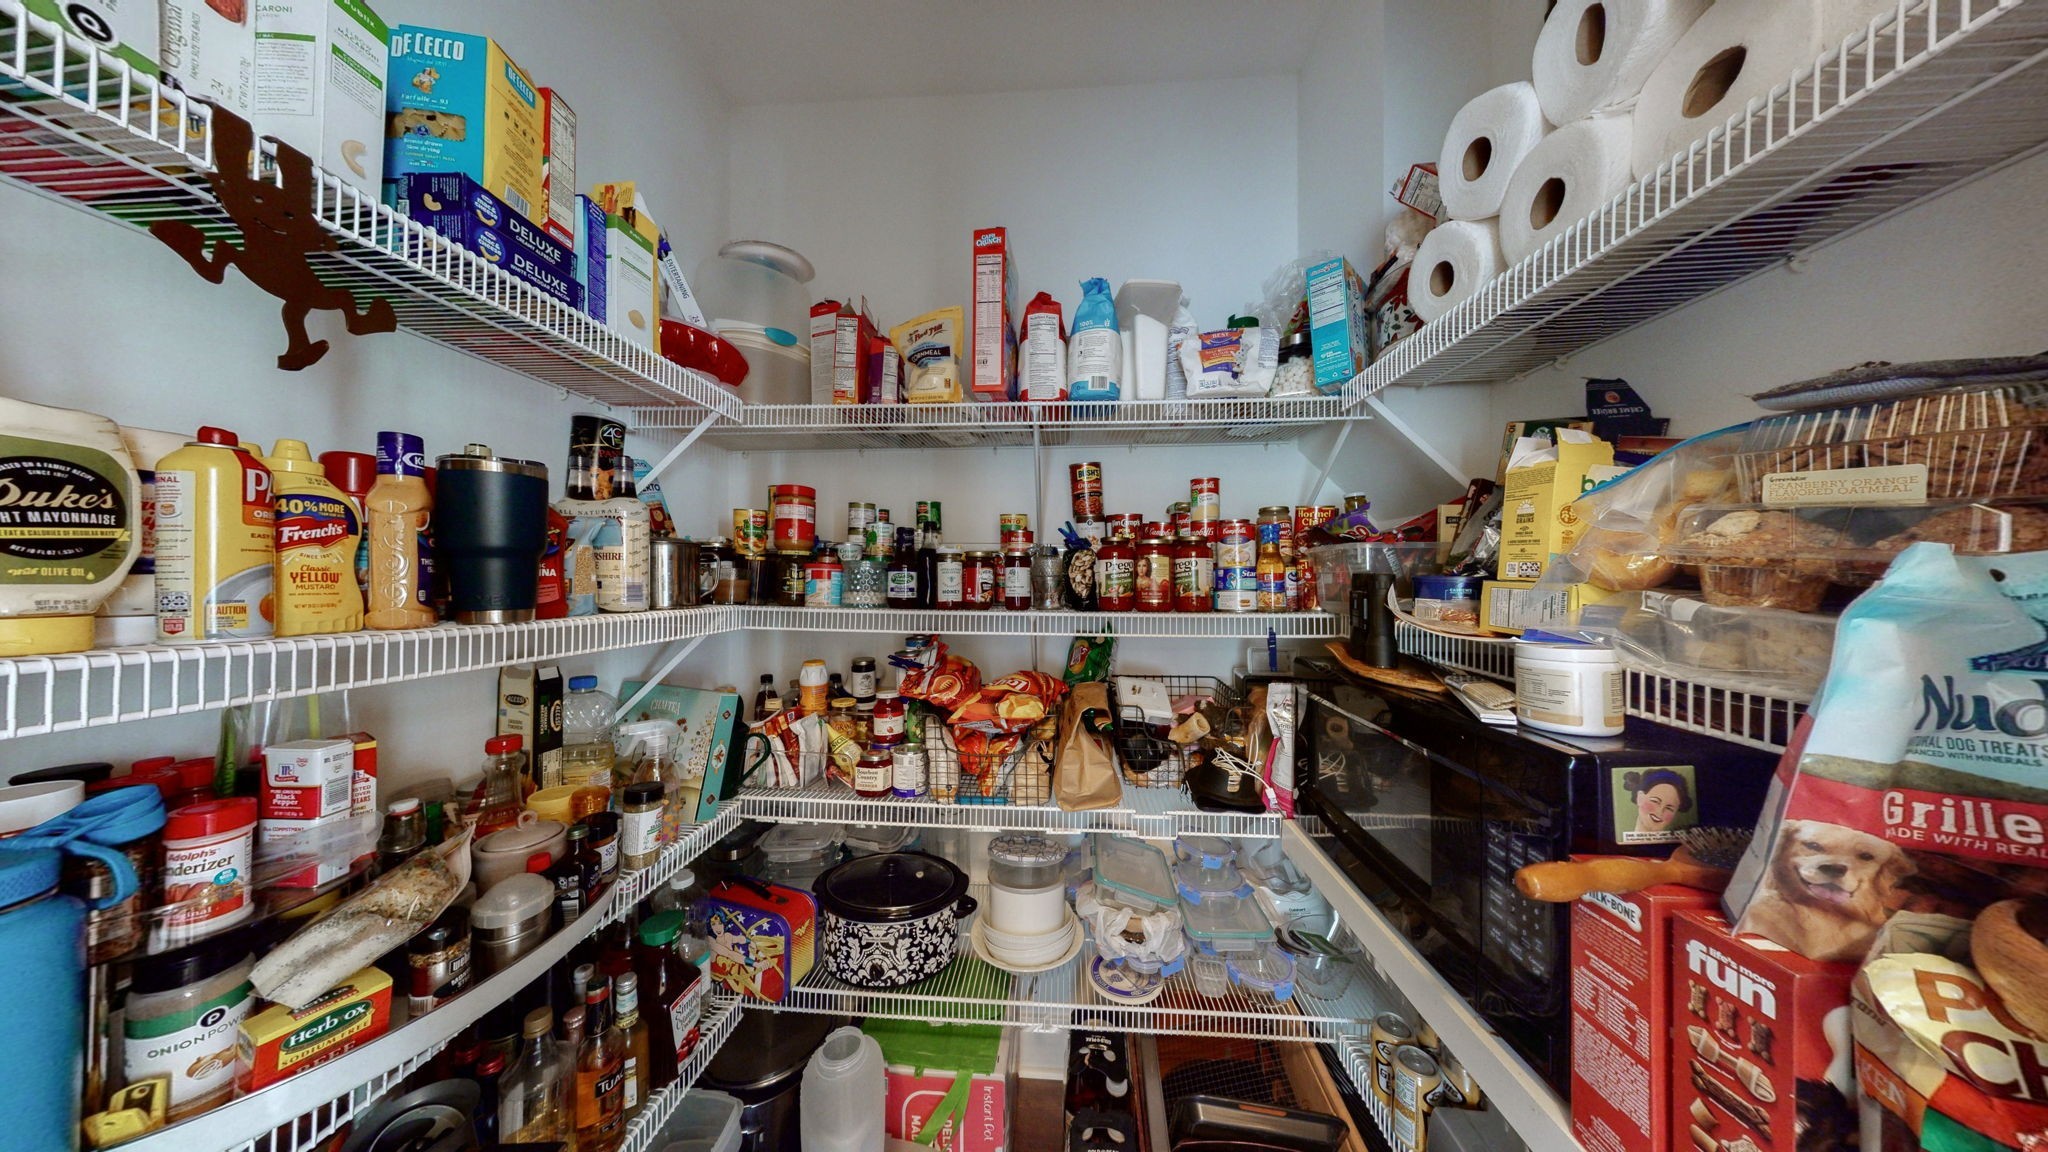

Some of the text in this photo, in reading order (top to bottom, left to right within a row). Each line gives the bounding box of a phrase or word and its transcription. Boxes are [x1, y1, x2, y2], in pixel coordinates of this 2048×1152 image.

[391, 33, 465, 61] DE CECCO
[509, 218, 562, 263] DELUXE
[976, 236, 1002, 247] CRUNCH
[514, 253, 569, 295] DELUXE
[666, 258, 690, 300] ENTERTAINING
[911, 349, 942, 362] CORNMEAL
[1769, 475, 1920, 490] CRANBERRY ORANGE
[1769, 484, 1913, 497] FLAVORED OATMEAL
[0, 477, 117, 509] Duke's
[319, 502, 346, 514] MORE
[577, 508, 620, 516] NATURAL
[1298, 509, 1332, 519] Hormel
[27, 510, 117, 526] MAYONNAISE
[279, 522, 344, 544] French's
[40, 566, 86, 577] OLIVE OIL
[300, 564, 332, 572] Classic
[1105, 560, 1134, 573] Prego
[289, 572, 340, 584] YELLOW
[1946, 736, 2048, 759] DOG TREATS
[1948, 752, 2043, 768] WITH MINERALS
[272, 799, 299, 807] Pepper
[1933, 831, 1989, 852] WITH
[1995, 839, 2048, 859] REAL
[1708, 946, 1777, 991] life's more
[1685, 939, 1777, 1020] fun
[288, 1016, 339, 1048] Herb
[147, 1033, 206, 1059] ONION
[281, 1020, 369, 1068] SODIUM FREE
[983, 1085, 996, 1141] Instant Pot
